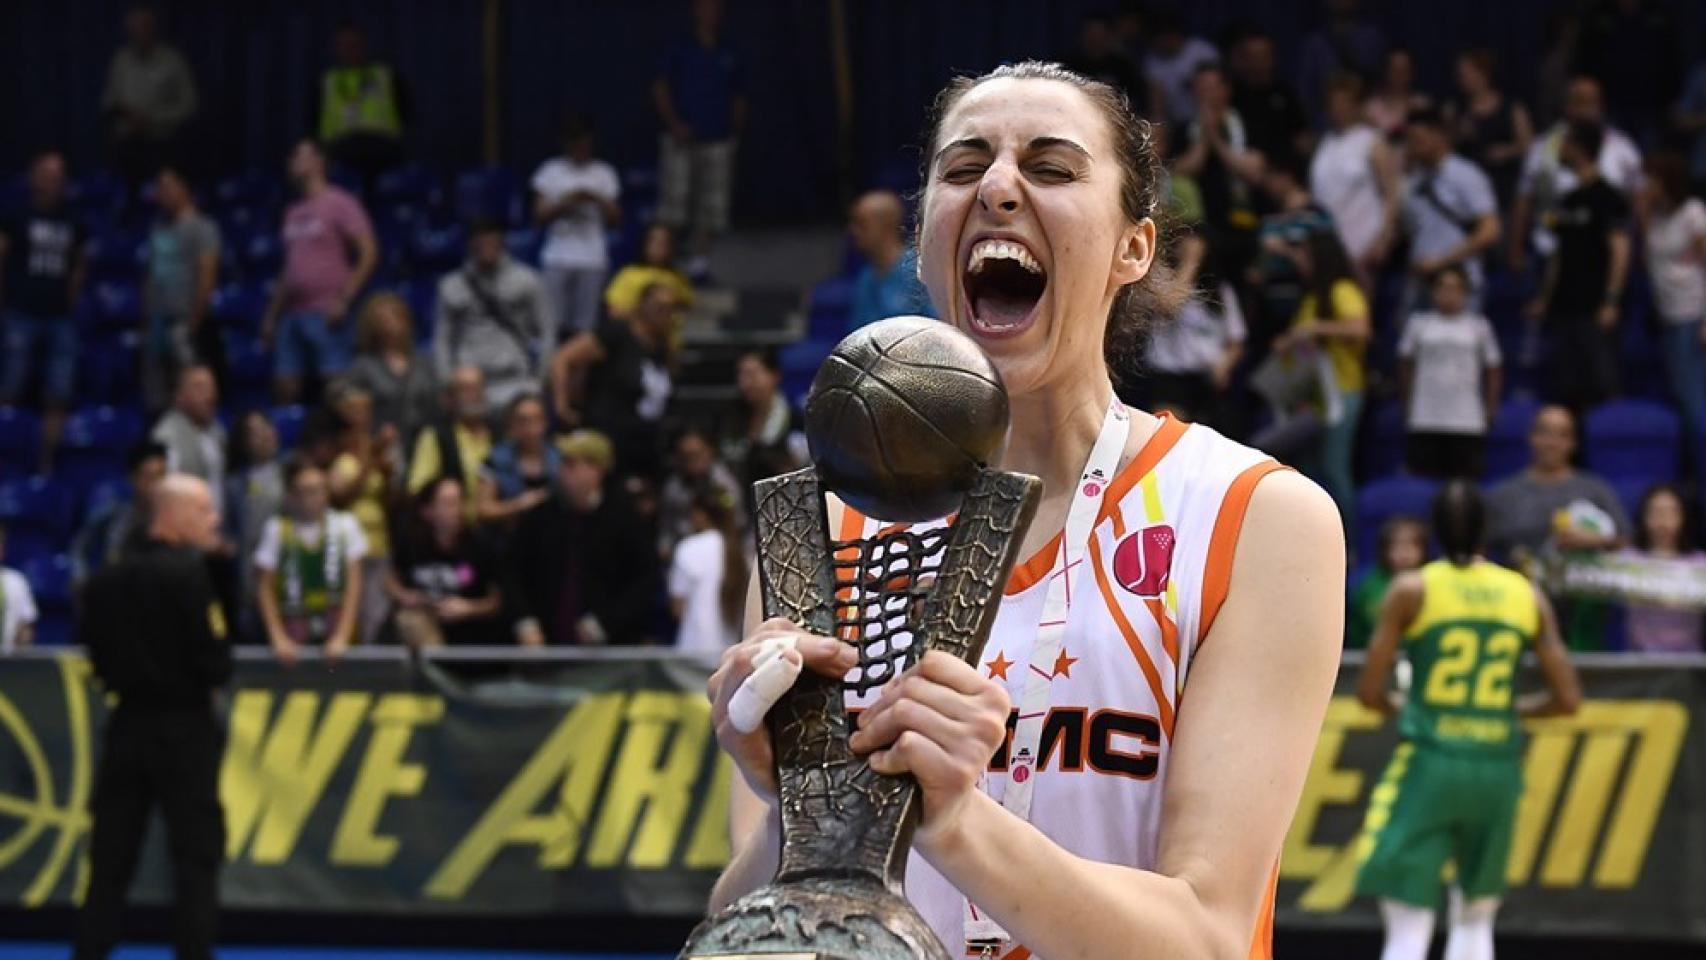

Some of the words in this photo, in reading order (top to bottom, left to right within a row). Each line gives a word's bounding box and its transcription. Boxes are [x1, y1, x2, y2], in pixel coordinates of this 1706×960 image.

[1424, 626, 1522, 708] 22
[218, 690, 445, 864] WE
[424, 689, 734, 898] AR
